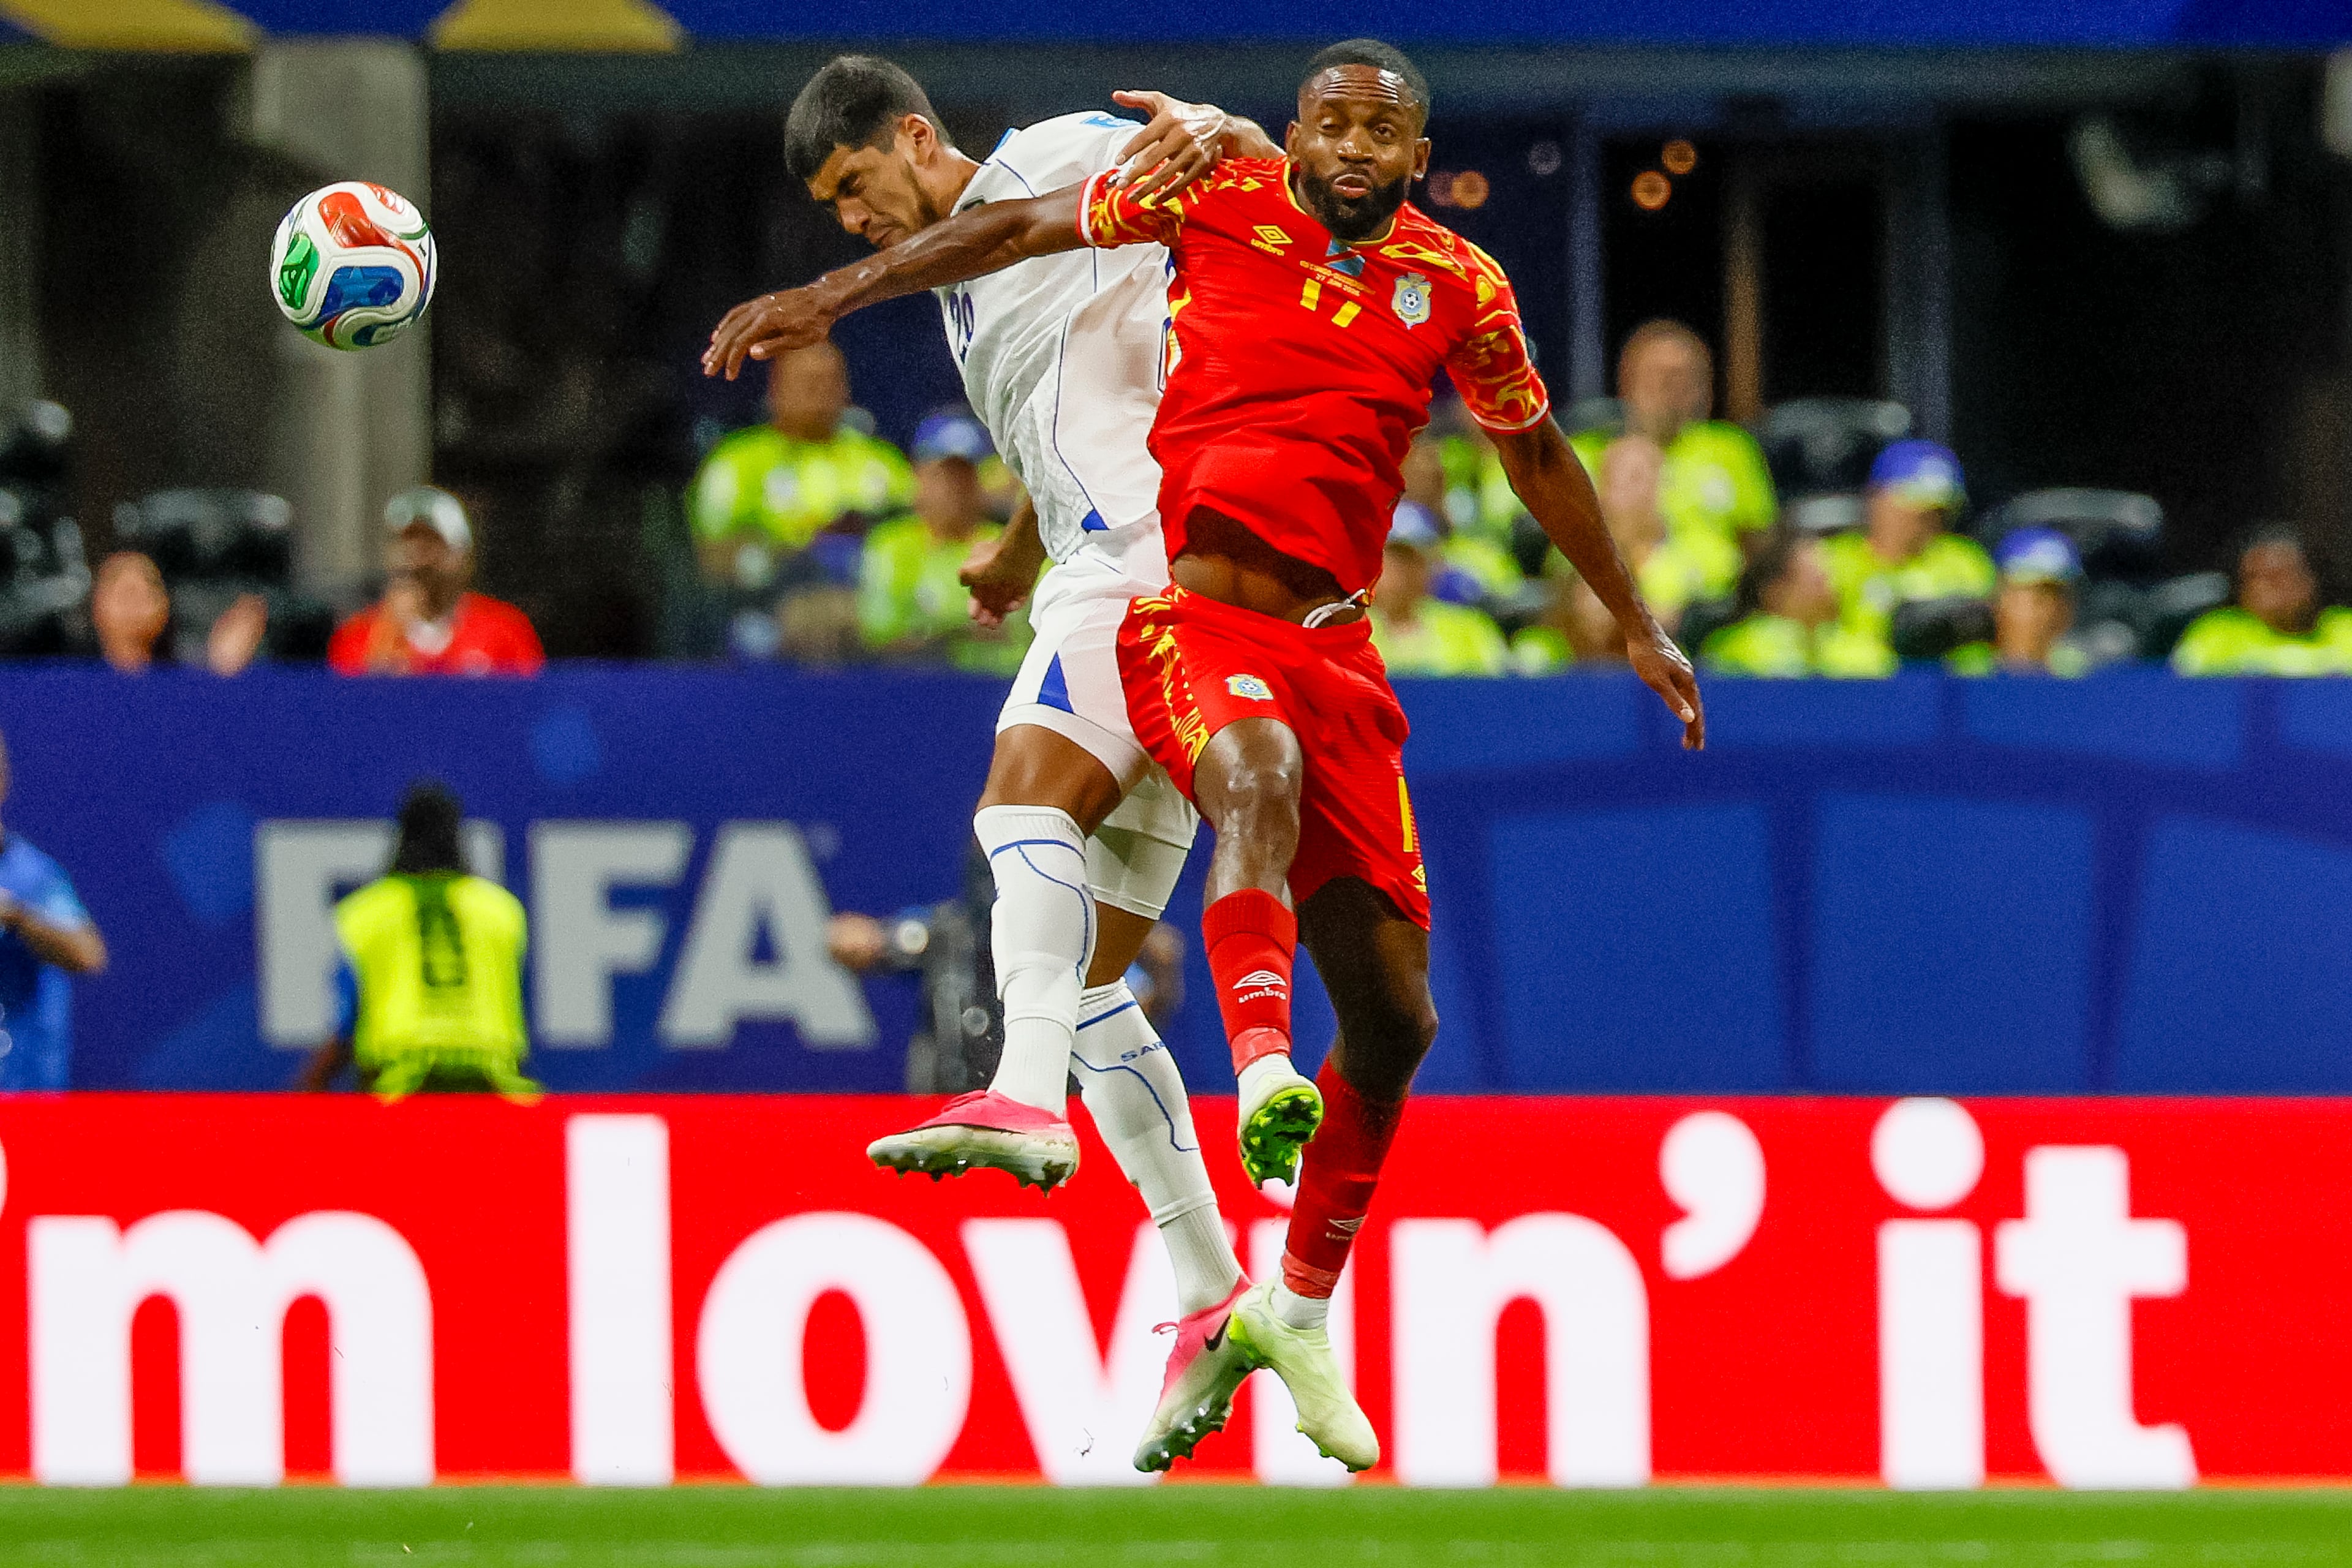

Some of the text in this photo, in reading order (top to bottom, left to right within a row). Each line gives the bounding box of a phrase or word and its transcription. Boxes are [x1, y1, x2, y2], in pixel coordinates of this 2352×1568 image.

[256, 820, 878, 1049] FFA
[1238, 987, 1287, 1004] umbro
[0, 1137, 435, 1487] m
[1870, 1096, 2200, 1490] it
